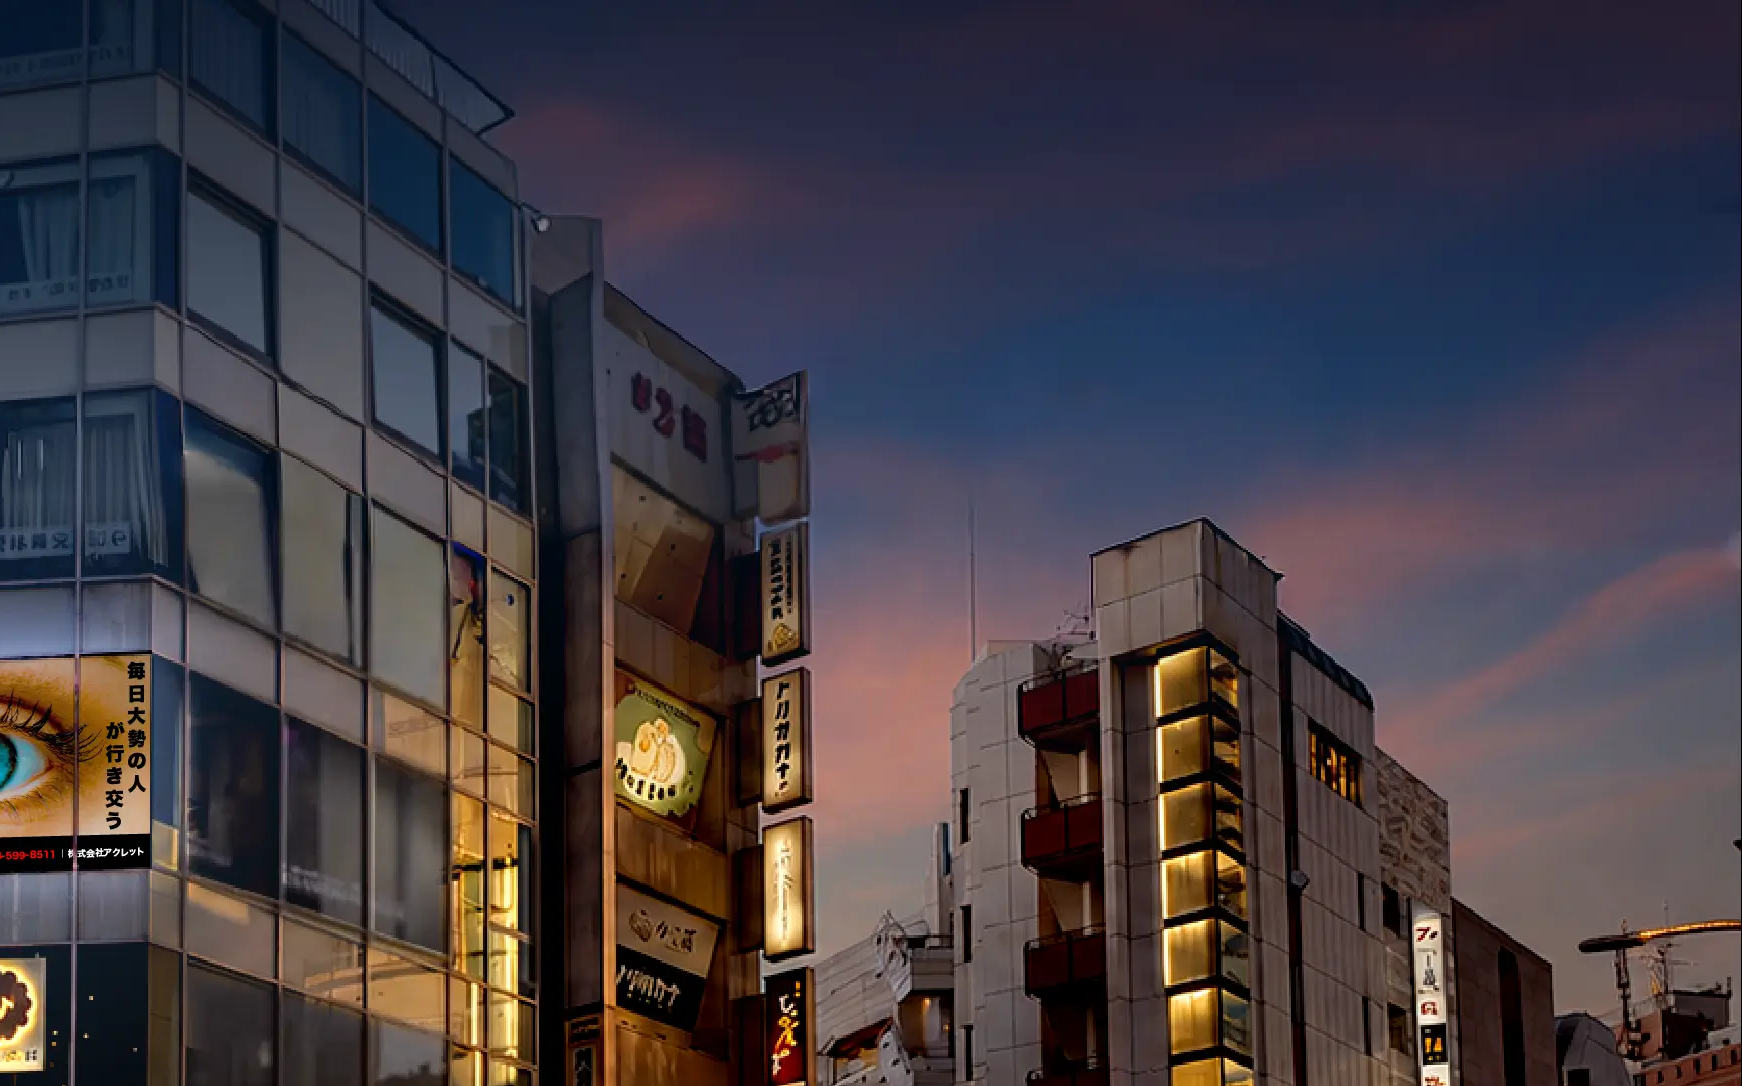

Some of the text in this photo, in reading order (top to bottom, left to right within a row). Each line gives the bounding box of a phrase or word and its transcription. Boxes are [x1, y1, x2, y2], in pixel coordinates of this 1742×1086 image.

[105, 721, 125, 830] が行き交う
[127, 661, 147, 794] 毎日大勢の人
